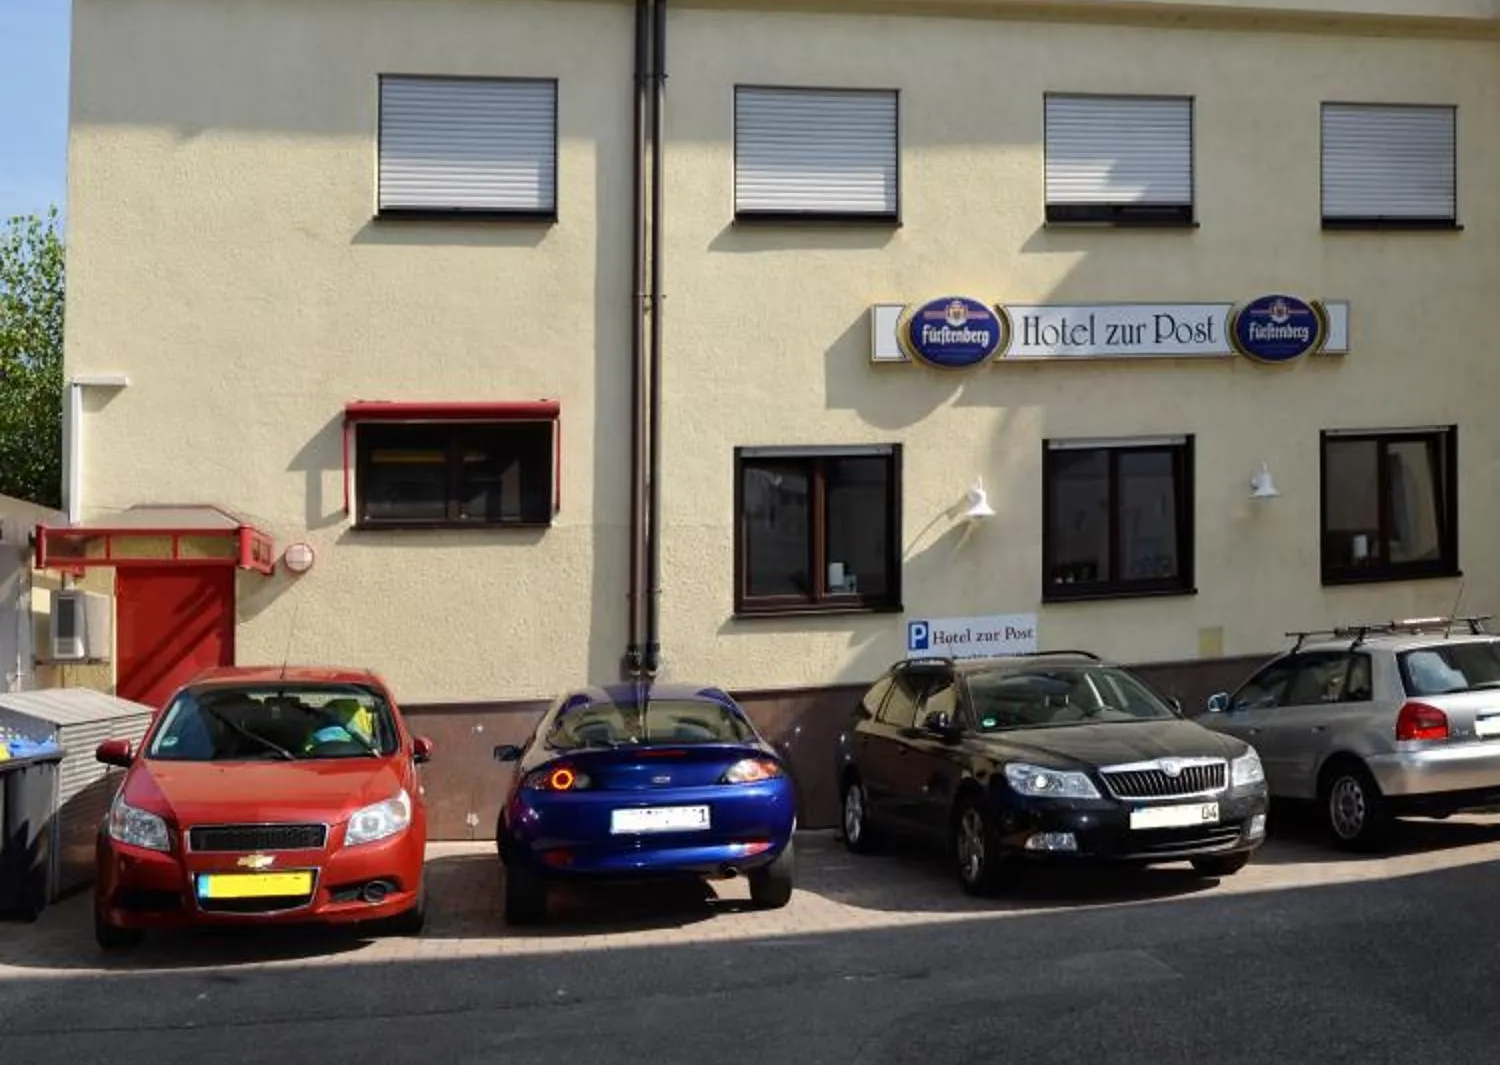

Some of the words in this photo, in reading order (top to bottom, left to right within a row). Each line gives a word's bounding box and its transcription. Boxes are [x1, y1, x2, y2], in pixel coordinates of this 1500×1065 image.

[1023, 313, 1096, 346] Hotel
[1105, 323, 1146, 346] zur
[1152, 312, 1215, 344] Post
[910, 623, 926, 649] P
[932, 627, 971, 645] Hotel
[975, 632, 999, 642] zur
[1005, 625, 1033, 640] Post
